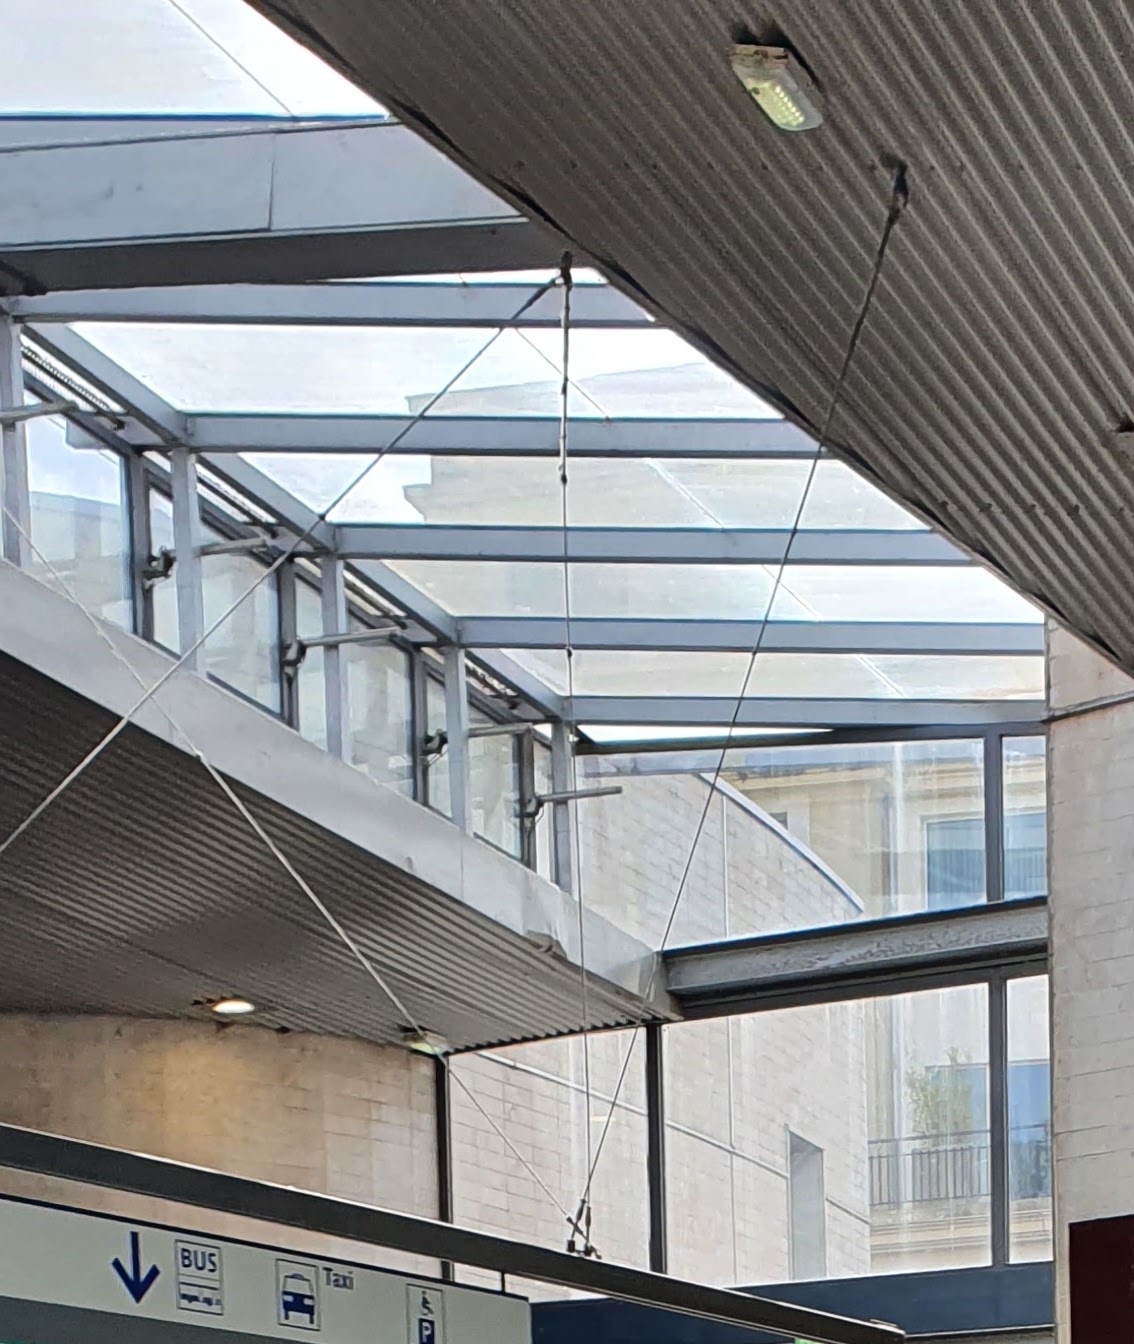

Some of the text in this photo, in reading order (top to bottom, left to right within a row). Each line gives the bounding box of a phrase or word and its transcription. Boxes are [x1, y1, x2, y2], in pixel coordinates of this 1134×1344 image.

[180, 1247, 218, 1273] BUS
[322, 1266, 355, 1291] Taxi
[422, 1321, 433, 1344] P
